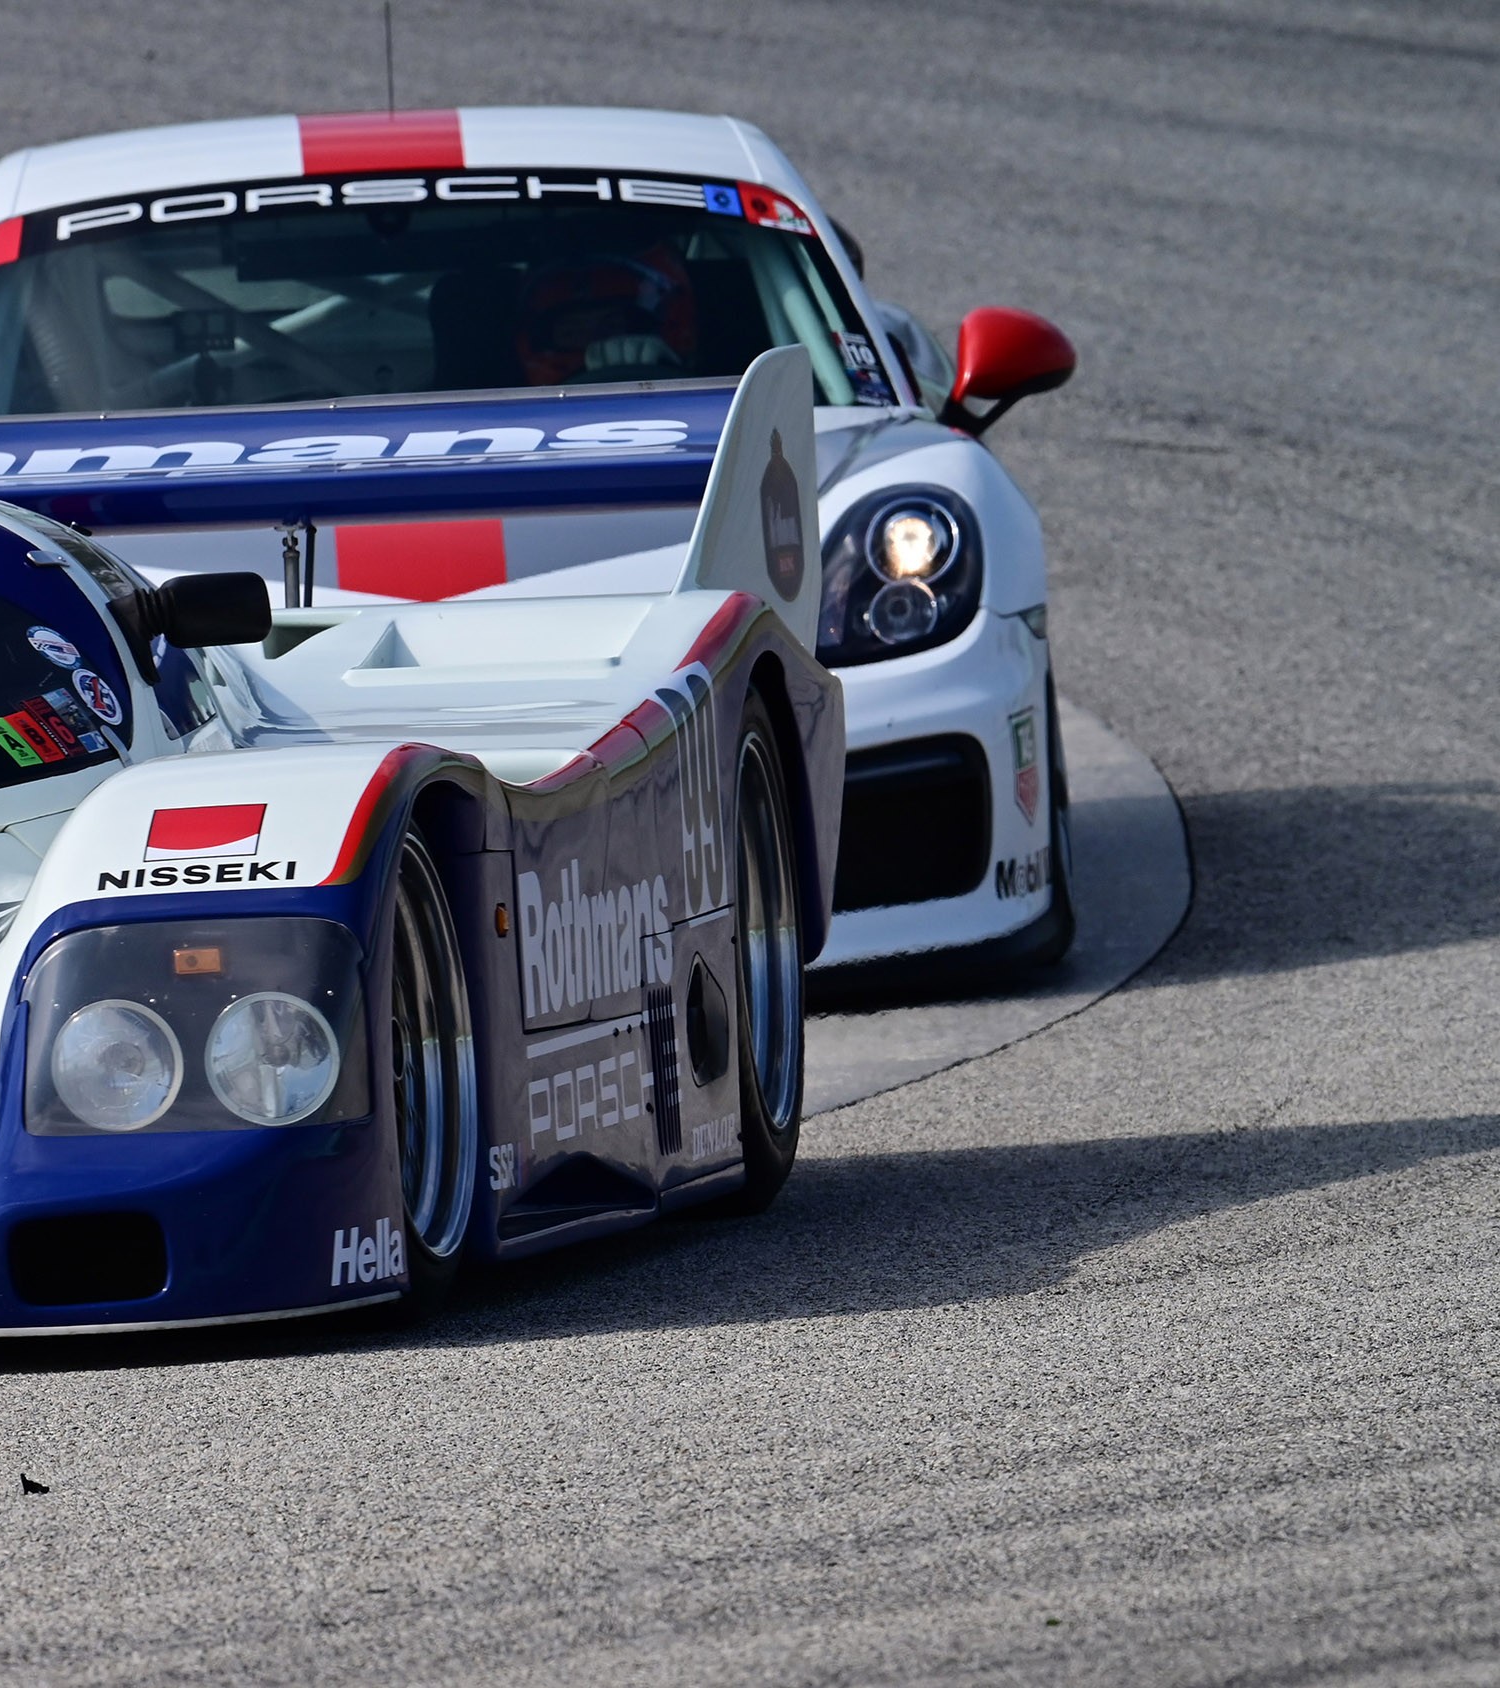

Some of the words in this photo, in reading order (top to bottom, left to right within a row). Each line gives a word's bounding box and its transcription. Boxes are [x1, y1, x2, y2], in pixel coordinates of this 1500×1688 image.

[56, 175, 706, 240] PORSCHE
[654, 660, 729, 919] 99
[98, 861, 297, 891] NISSEKI
[518, 859, 673, 1018] Rothmans
[528, 1038, 683, 1149] PORSCHE
[489, 1142, 516, 1191] SSR
[692, 1113, 736, 1162] DUNLOP
[331, 1217, 405, 1287] Hella
